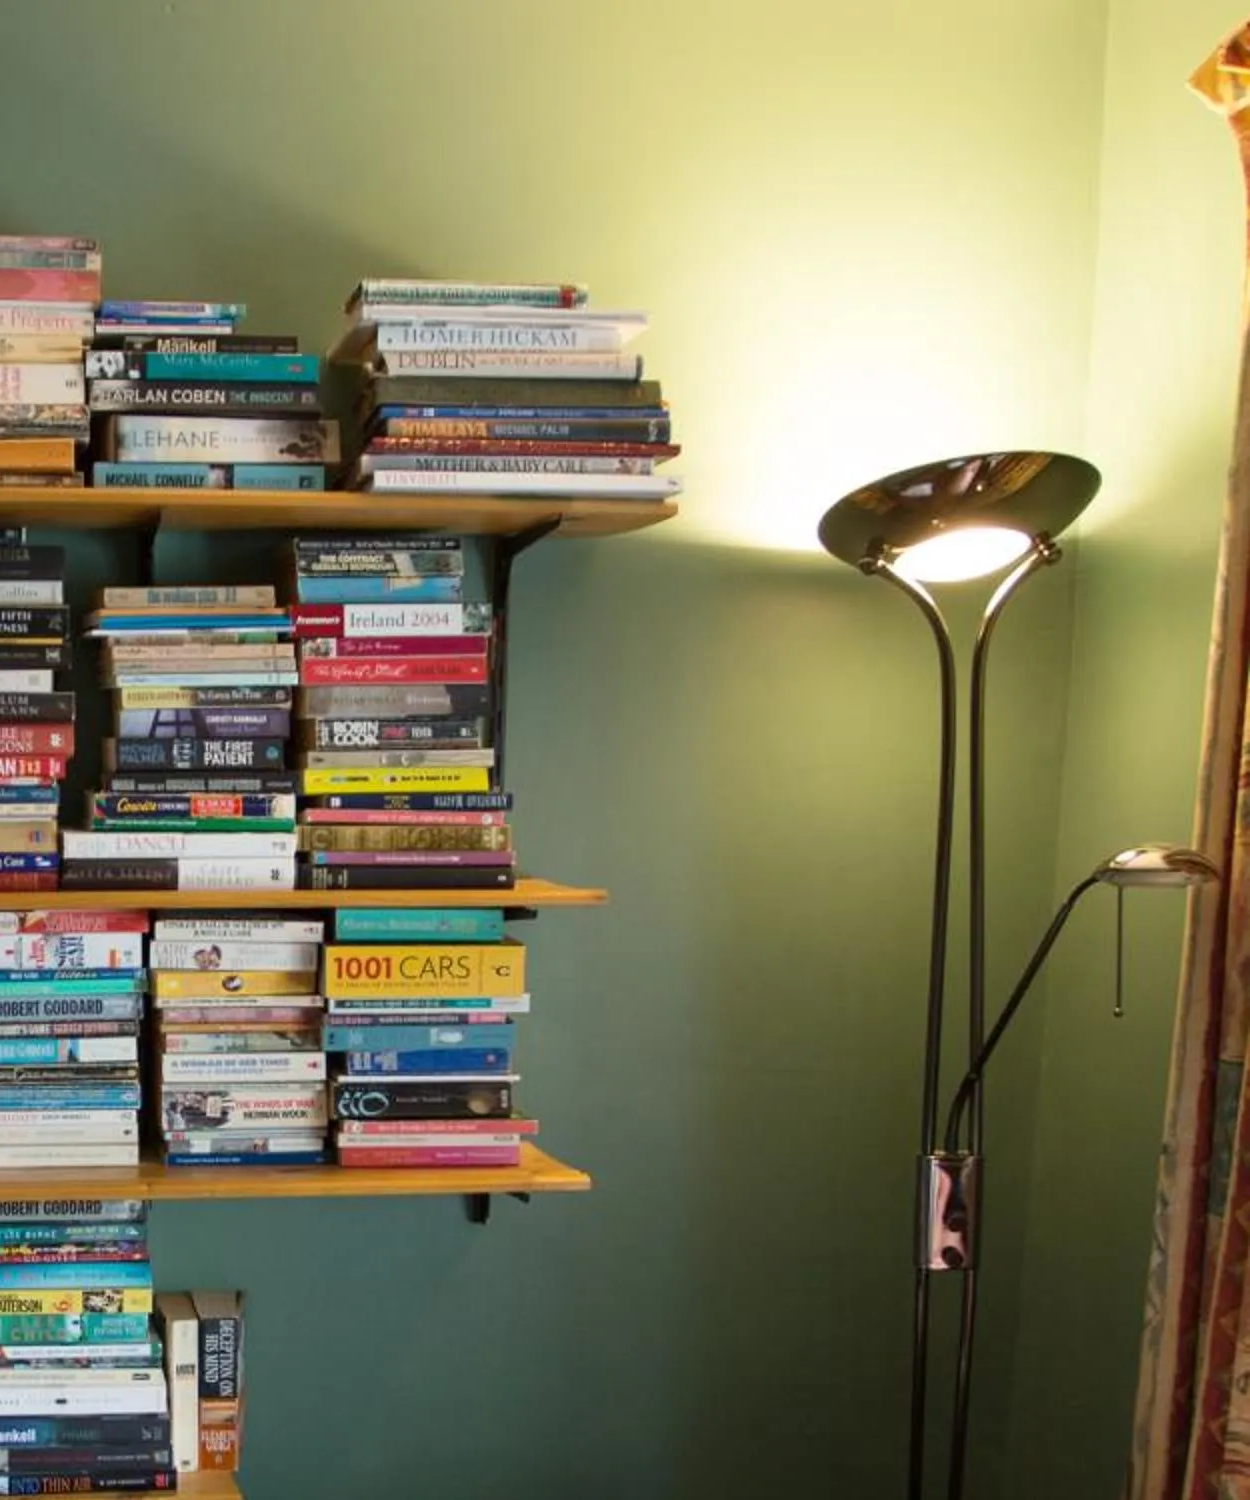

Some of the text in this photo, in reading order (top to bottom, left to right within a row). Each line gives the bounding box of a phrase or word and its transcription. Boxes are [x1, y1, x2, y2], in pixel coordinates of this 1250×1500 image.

[403, 328, 577, 348] HOMER HICKAM
[398, 352, 477, 370] DUBLIN
[171, 389, 227, 405] COBEN
[132, 430, 221, 449] LEHANE
[416, 458, 487, 473] MOTHER
[1, 611, 31, 621] FIFTH
[350, 612, 450, 629] Ireland 2004
[333, 721, 379, 734] ROBIN
[204, 741, 253, 752] THE FIRST
[333, 734, 379, 746] COOK
[204, 752, 253, 766] PATIENT
[334, 955, 471, 980] 1001 CARS
[43, 1000, 104, 1016] GODDARD
[44, 1200, 103, 1215] GODDARD
[205, 1334, 219, 1383] HIS MIND
[220, 1319, 235, 1397] DECEPTION ON
[41, 1477, 69, 1492] THIN
